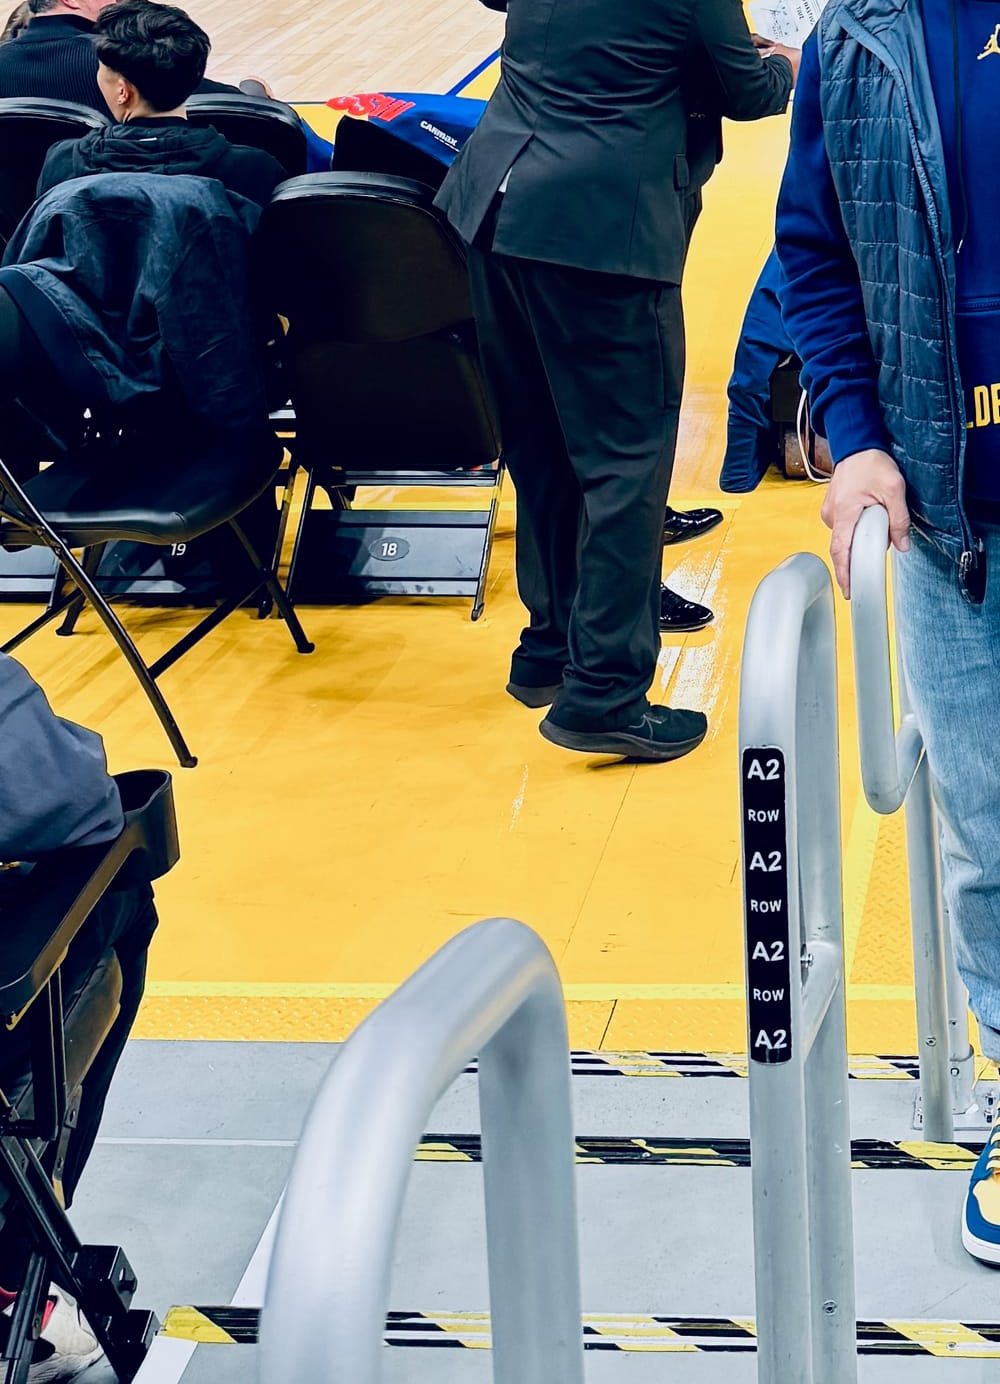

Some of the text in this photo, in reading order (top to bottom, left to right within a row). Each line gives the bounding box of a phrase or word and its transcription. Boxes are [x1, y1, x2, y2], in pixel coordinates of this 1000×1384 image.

[170, 542, 187, 557] 19
[381, 542, 398, 557] 18
[747, 758, 780, 781] A2
[748, 809, 780, 823] ROW
[749, 850, 782, 872] A2
[750, 899, 782, 913] ROW
[752, 940, 785, 962] A2
[753, 988, 785, 1002] ROW
[754, 1029, 787, 1050] A2
